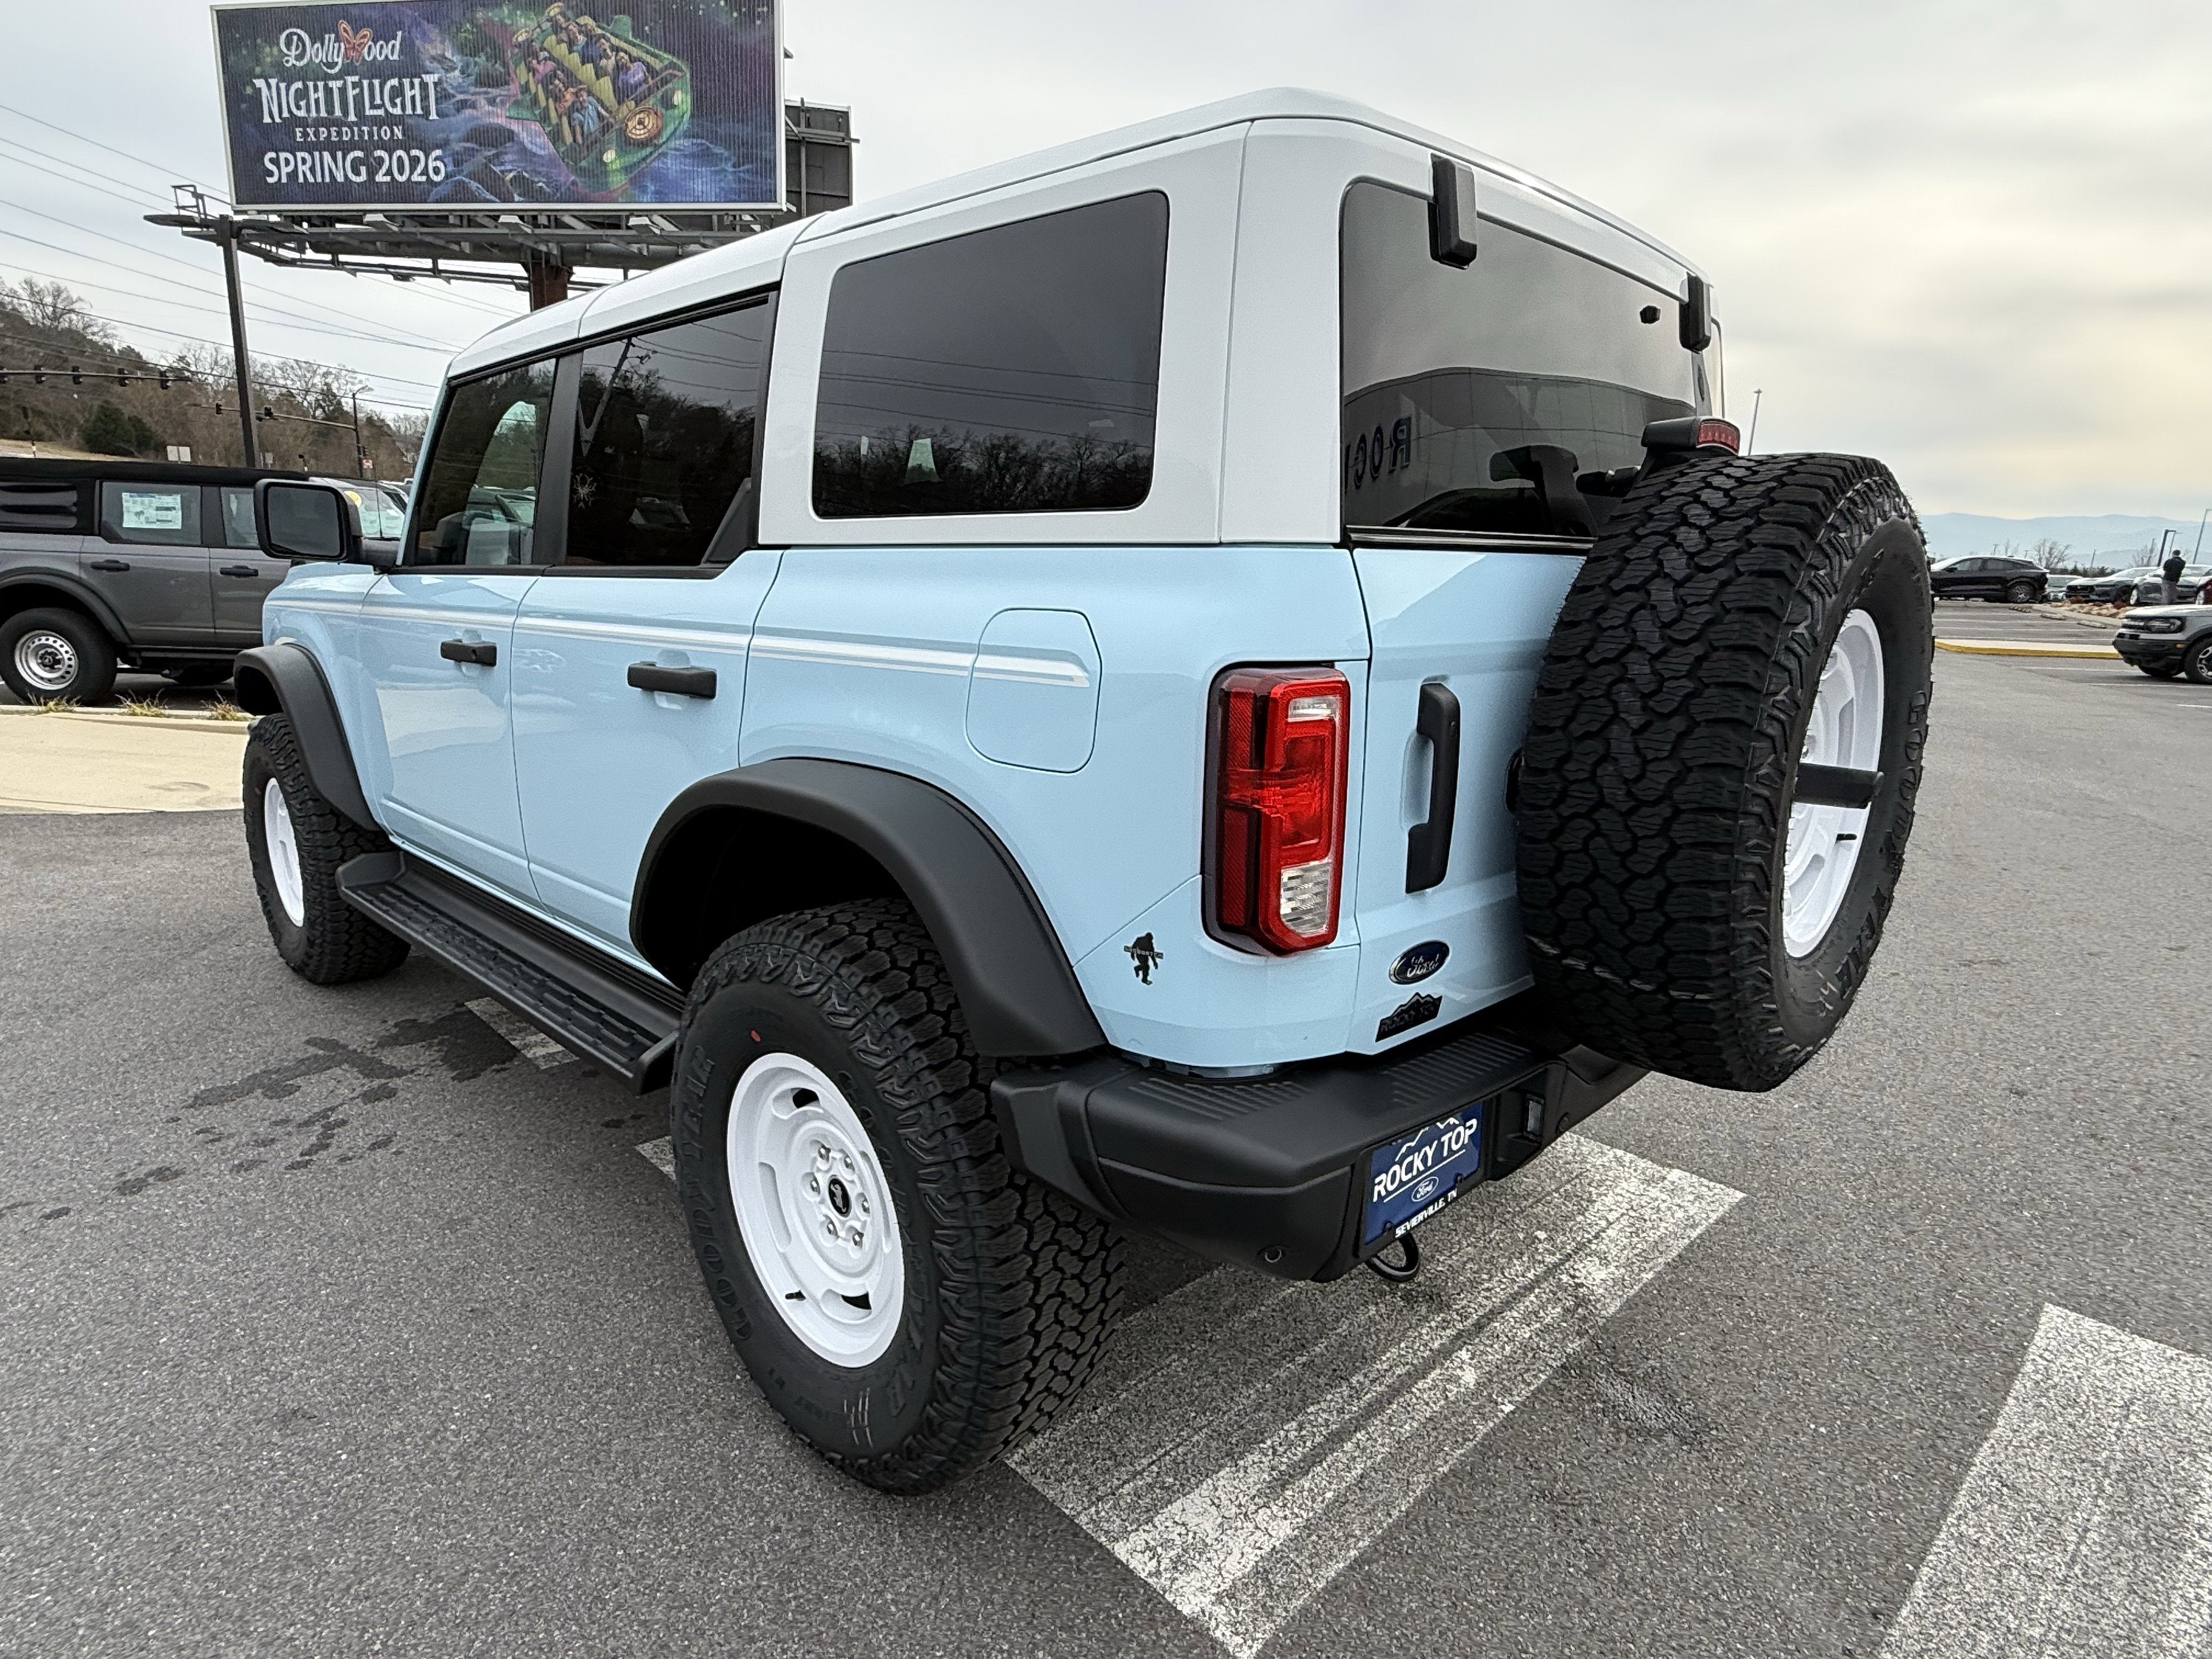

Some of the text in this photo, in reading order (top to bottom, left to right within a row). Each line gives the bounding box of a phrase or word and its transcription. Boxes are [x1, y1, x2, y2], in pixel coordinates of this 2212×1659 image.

[253, 75, 439, 123] NIGHTFLIGHT
[296, 126, 403, 142] EXPEDITION
[264, 150, 445, 183] SPRING 2026
[1406, 953, 1440, 978] Ford
[1373, 1118, 1477, 1202] ROCKY TOP
[1448, 1188, 1457, 1202] TN
